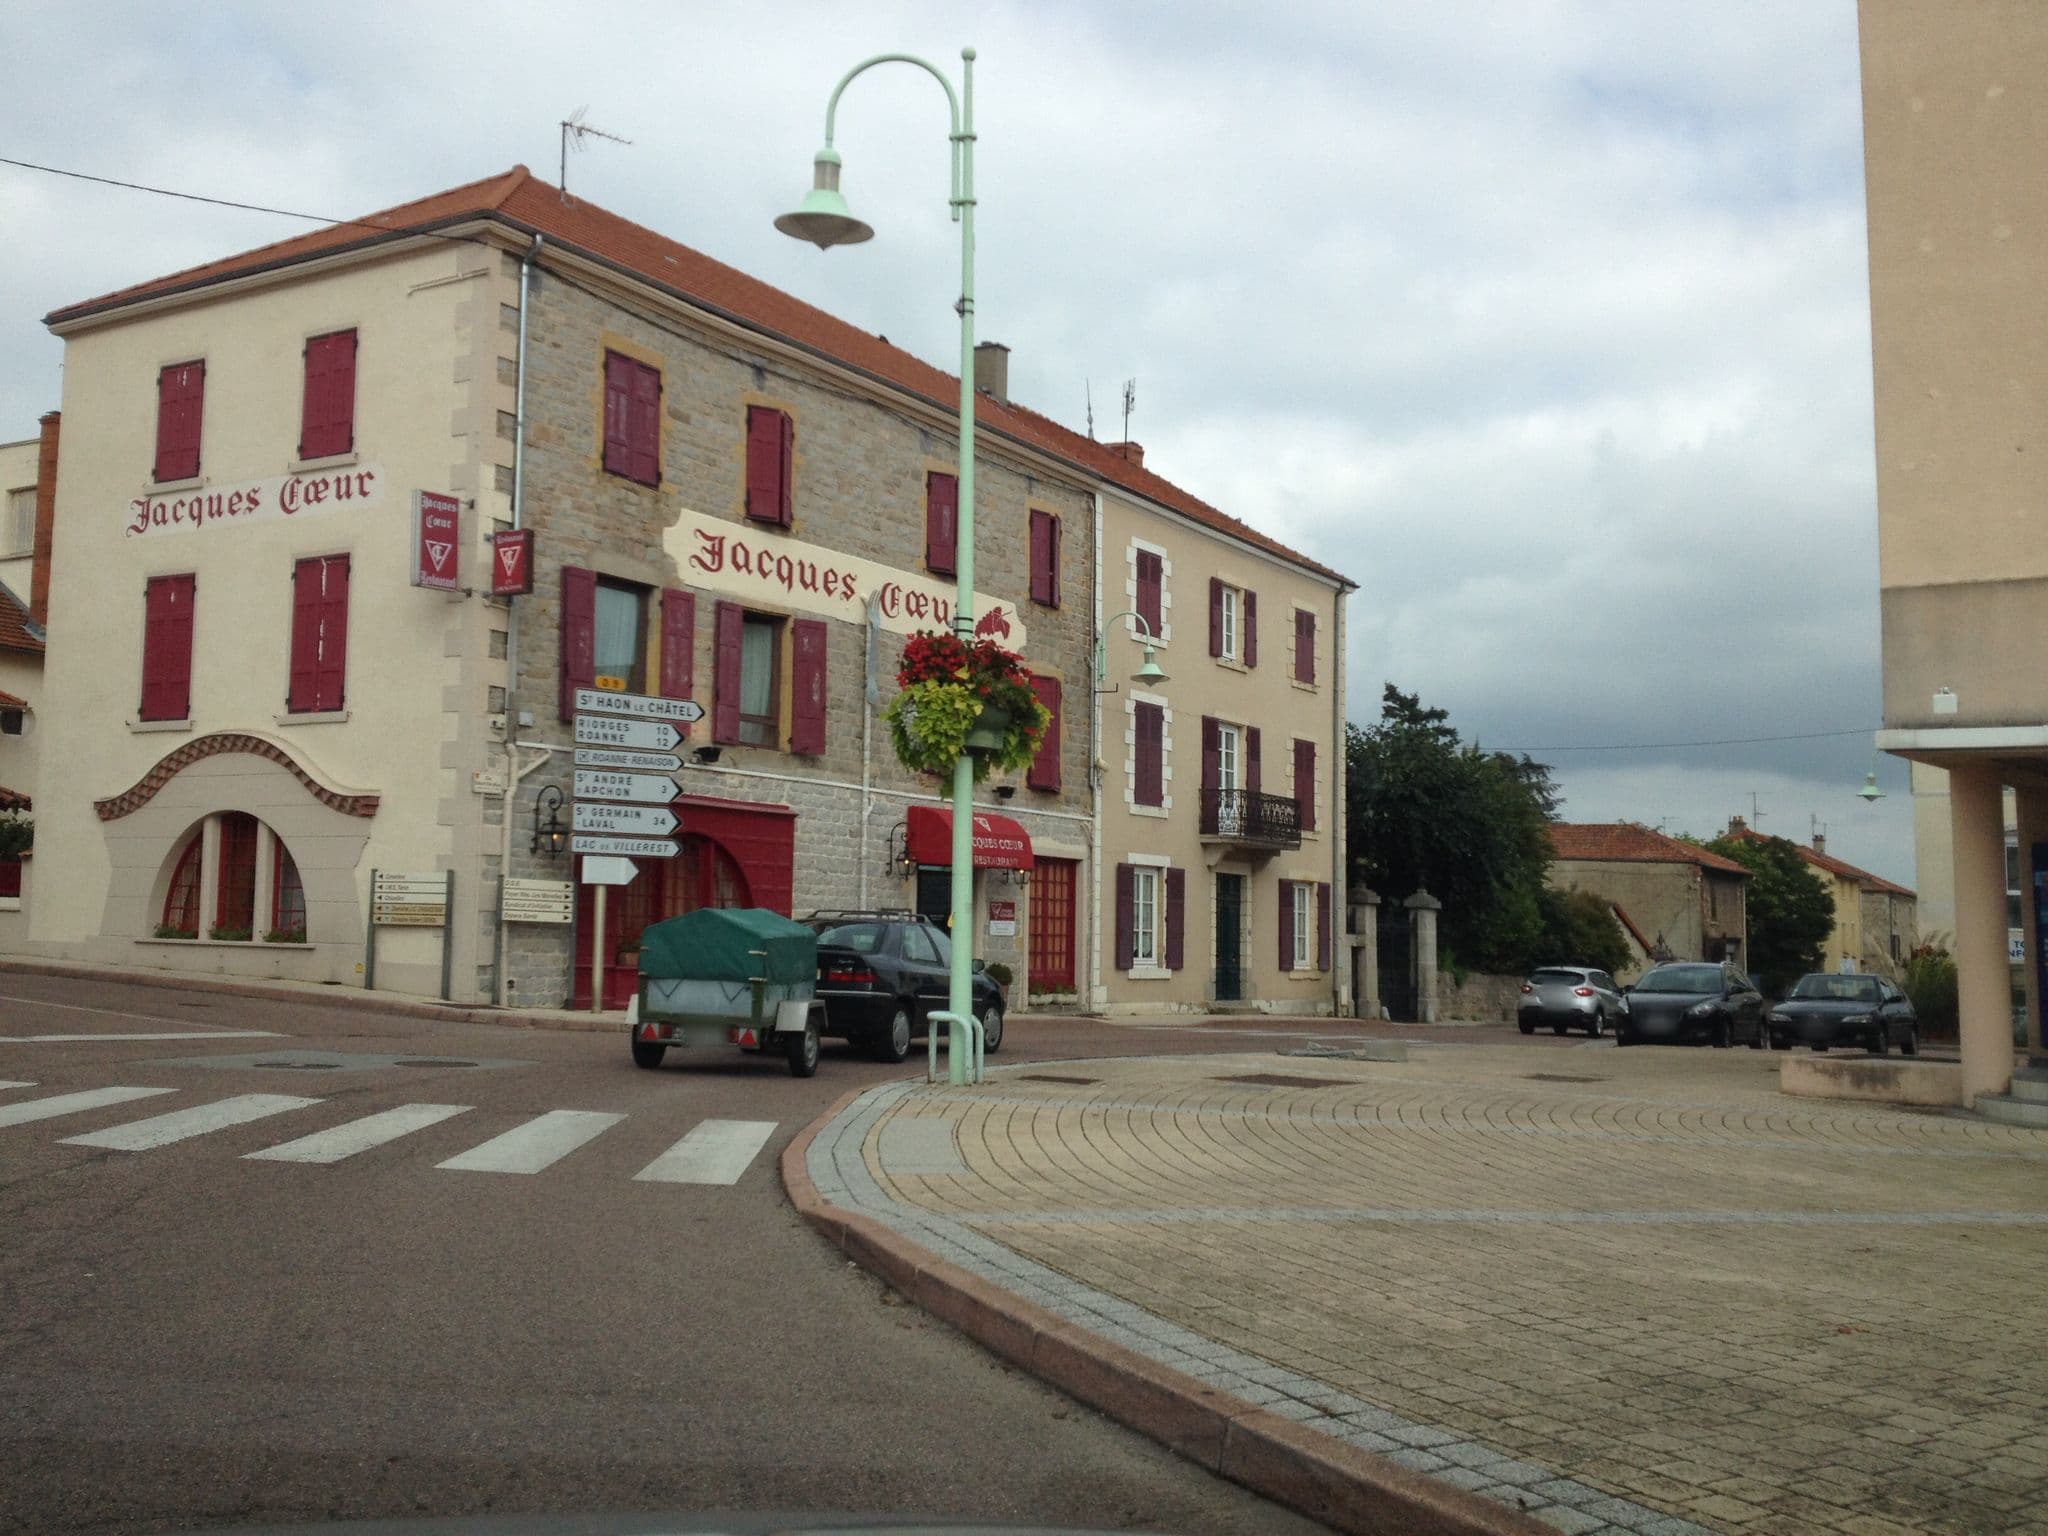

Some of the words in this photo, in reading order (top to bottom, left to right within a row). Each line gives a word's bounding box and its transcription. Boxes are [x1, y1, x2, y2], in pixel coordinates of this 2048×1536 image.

[126, 484, 262, 538] Jacques
[278, 469, 376, 516] Cœur
[419, 494, 457, 513] Jacques
[688, 528, 858, 602] Jacques
[879, 582, 960, 628] Cœu
[596, 696, 631, 710] HAON
[634, 703, 644, 712] LE
[647, 701, 693, 717] CHÂTEL
[578, 718, 630, 732] RIORGES
[657, 726, 669, 736] 10
[578, 730, 625, 743] ROANNE
[657, 737, 669, 747] 12
[593, 774, 633, 786] ANDRÉ
[661, 785, 668, 794] 3
[591, 807, 642, 819] GERMAIN
[653, 816, 666, 826] 34
[575, 840, 595, 850] LAC
[614, 842, 670, 853] VILLEREST
